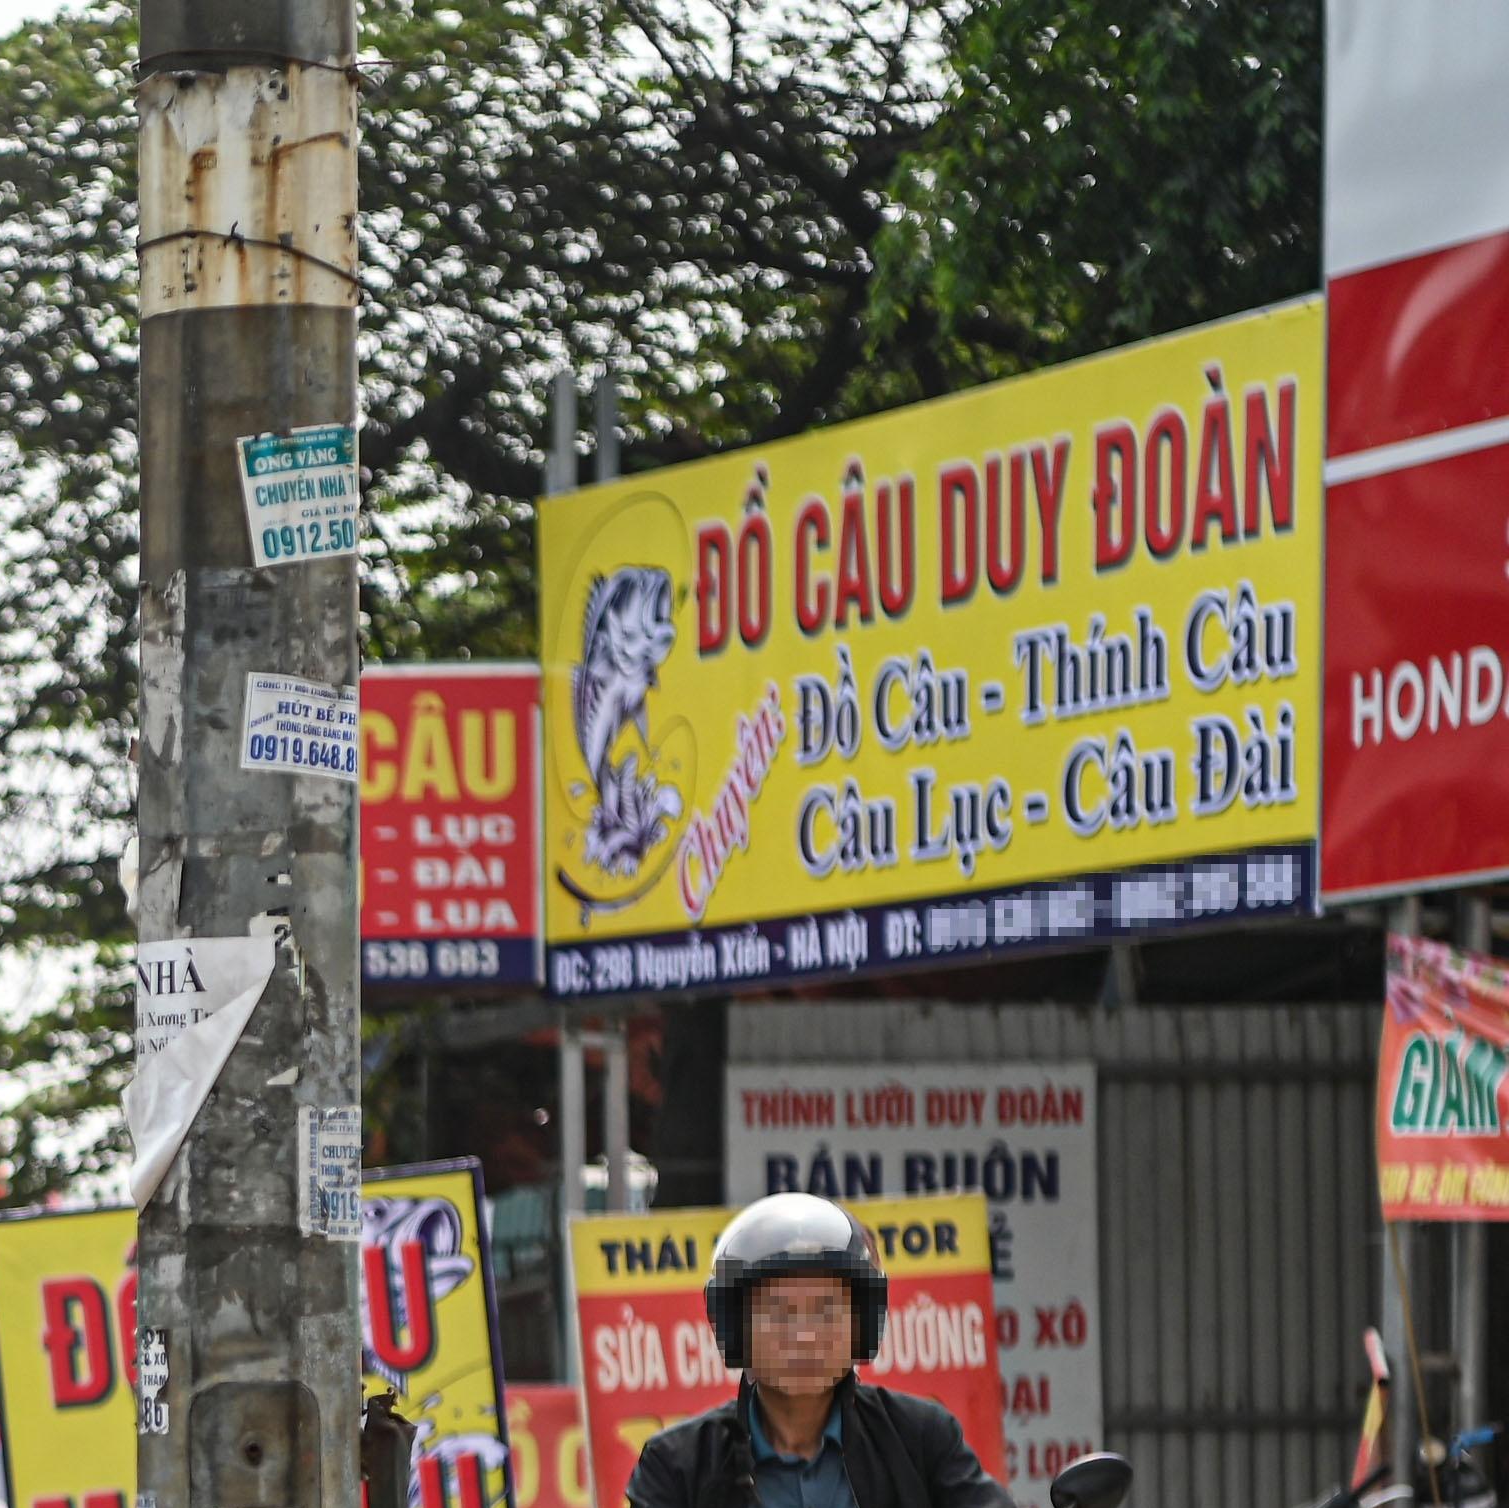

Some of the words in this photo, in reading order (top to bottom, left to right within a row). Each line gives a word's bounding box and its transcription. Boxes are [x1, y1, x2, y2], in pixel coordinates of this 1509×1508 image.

[255, 470, 316, 507] CHUYỂN
[319, 471, 347, 498] NHÀ
[696, 463, 773, 656] ĐỒ
[795, 455, 915, 638] CÂU
[939, 435, 1073, 609] DUY
[1092, 364, 1296, 575] ĐOÀN
[262, 518, 357, 559] 0912.50
[795, 643, 861, 766] Đồ
[873, 648, 971, 753] Câu
[1014, 605, 1170, 725] Thính
[1185, 580, 1299, 694] Câu
[1350, 642, 1509, 750] HOND
[277, 699, 313, 718] HÚT
[316, 703, 335, 722] BỂ
[339, 710, 357, 726] PH
[359, 690, 516, 802] CÂU
[250, 733, 358, 774] 0919.648.8
[796, 775, 898, 878] Câu
[911, 763, 1012, 877] Lục
[1062, 726, 1178, 838] Câu
[1191, 700, 1297, 816] Đài
[679, 678, 786, 922] Chuyên:
[925, 1084, 986, 1128] DUY
[996, 1080, 1085, 1126] ĐOÀN
[766, 1140, 883, 1200] BÁN
[600, 1229, 697, 1276] THÁI
[594, 1305, 668, 1392] SỬA
